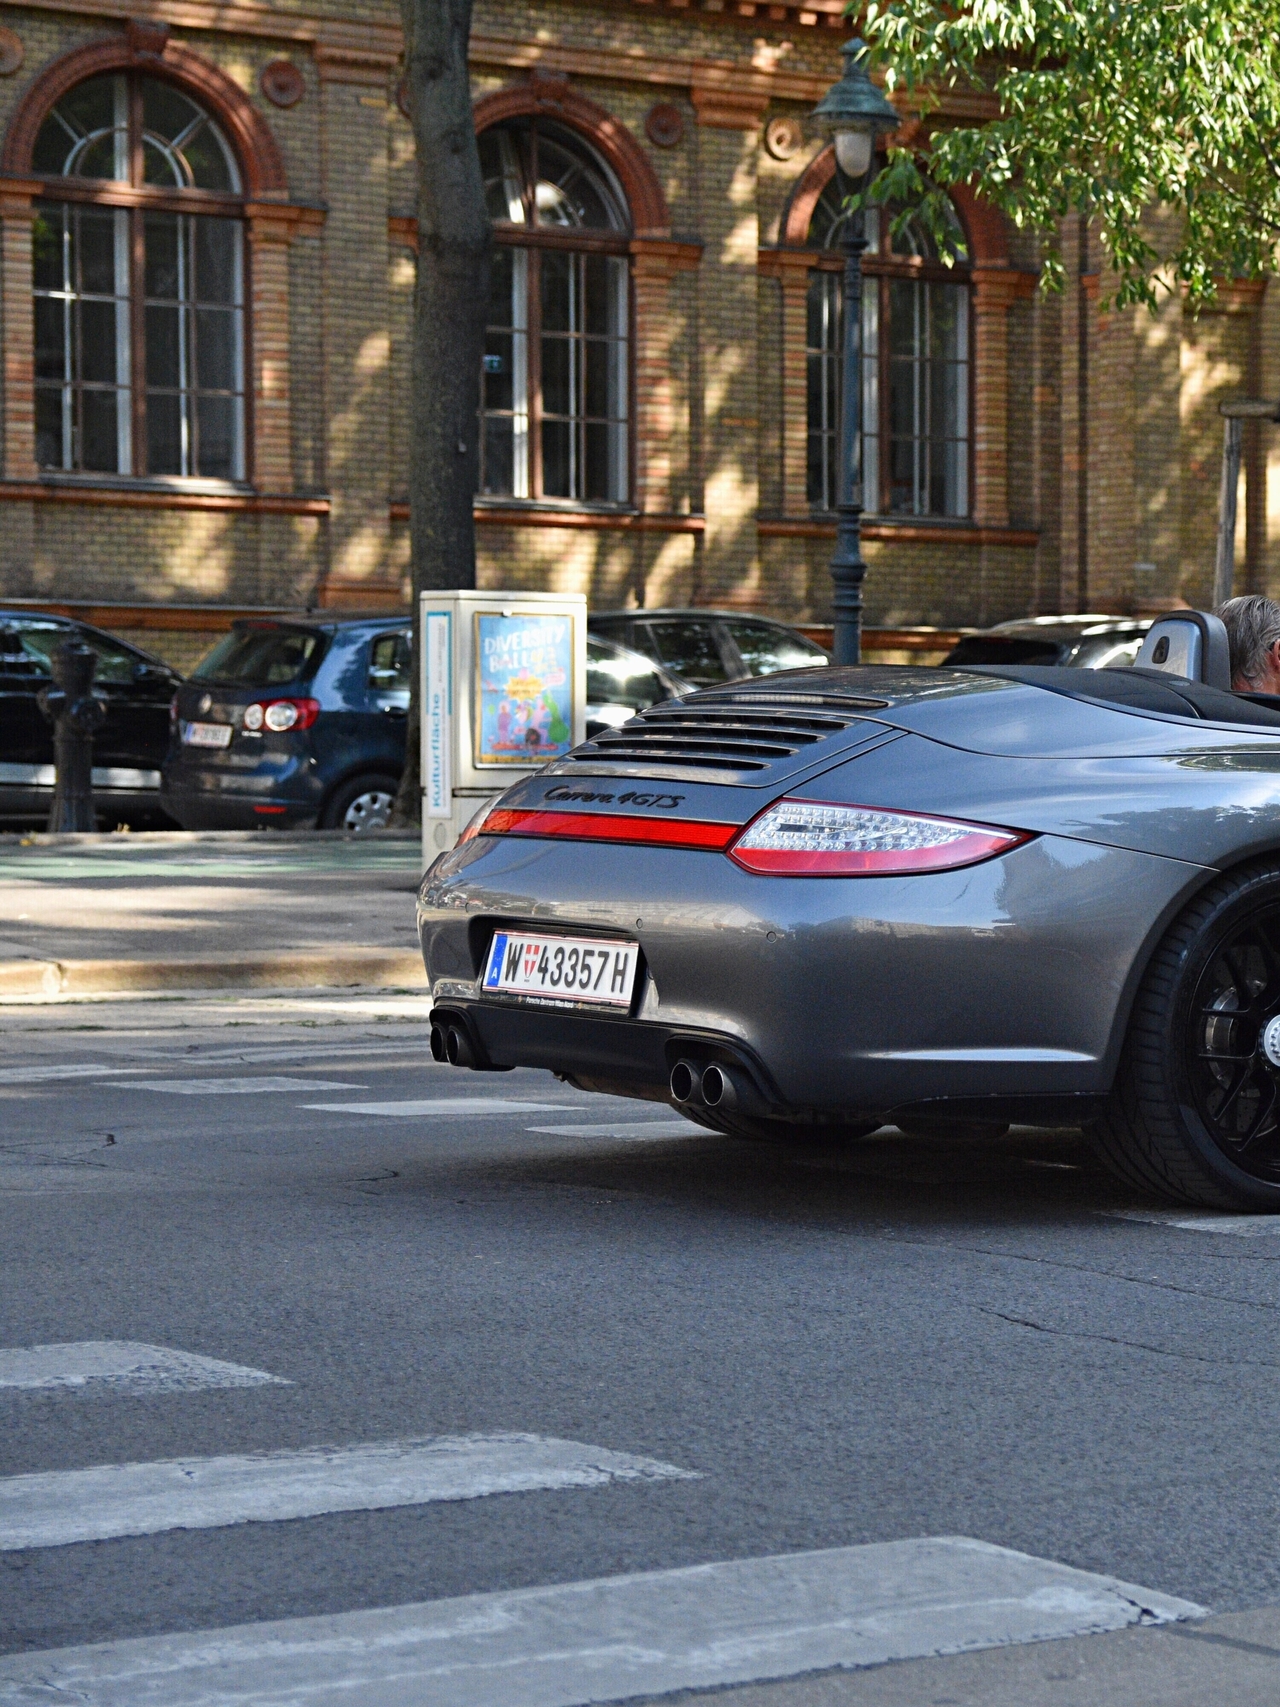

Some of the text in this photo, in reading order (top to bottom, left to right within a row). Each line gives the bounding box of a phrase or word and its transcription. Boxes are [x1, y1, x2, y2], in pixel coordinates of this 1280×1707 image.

[484, 624, 566, 655] DIVERSITY
[432, 693, 441, 807] Kulturfläche
[543, 785, 615, 803] Carrera
[491, 966, 498, 979] A
[504, 942, 525, 982] W
